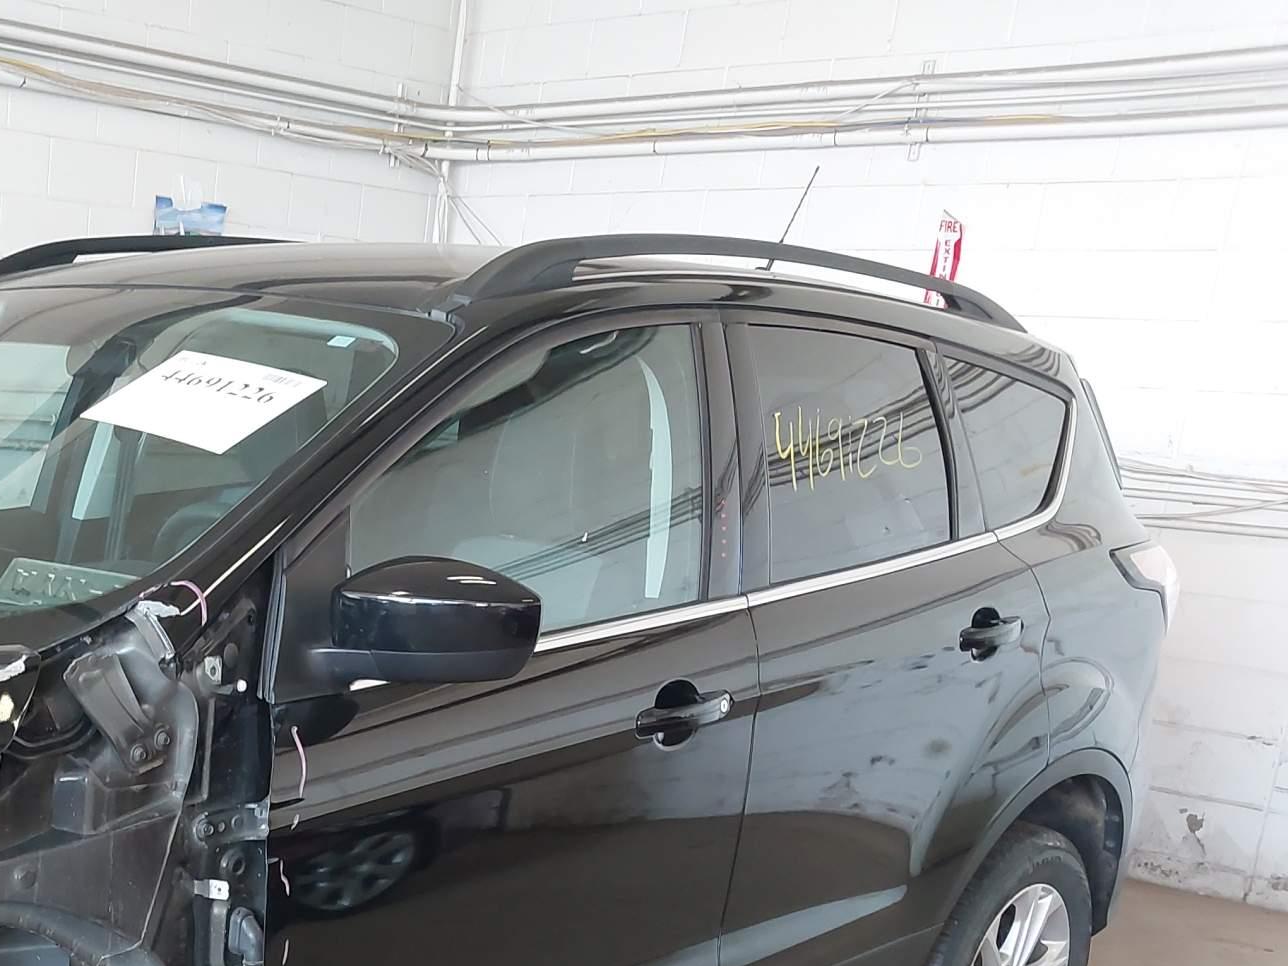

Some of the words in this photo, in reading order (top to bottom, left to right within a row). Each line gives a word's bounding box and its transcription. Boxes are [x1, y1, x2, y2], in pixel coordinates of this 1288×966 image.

[939, 219, 959, 233] FIRE
[161, 368, 276, 404] 44691226
[773, 406, 923, 492] 44691226
